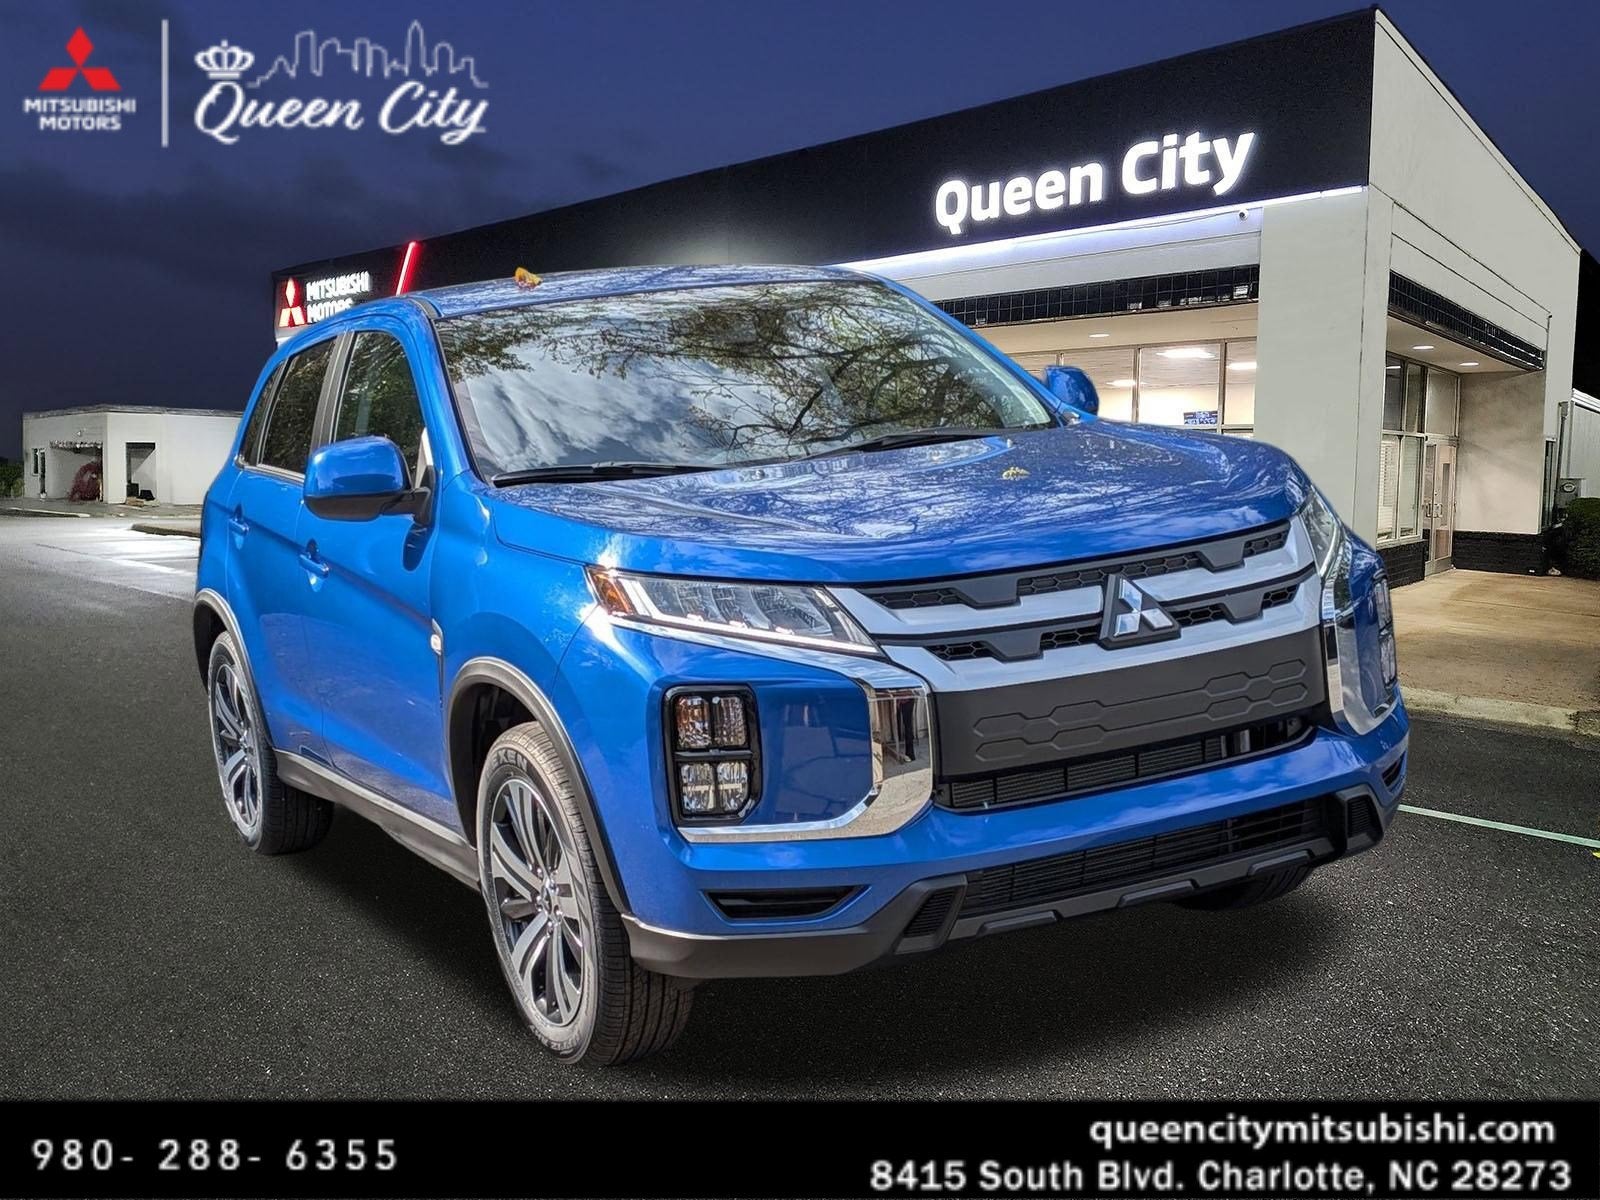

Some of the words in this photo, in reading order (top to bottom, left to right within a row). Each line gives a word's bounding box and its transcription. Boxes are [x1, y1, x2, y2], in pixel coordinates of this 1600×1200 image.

[935, 161, 1103, 235] Queen
[1121, 131, 1255, 196] City
[306, 270, 370, 301] MITSUBISHI
